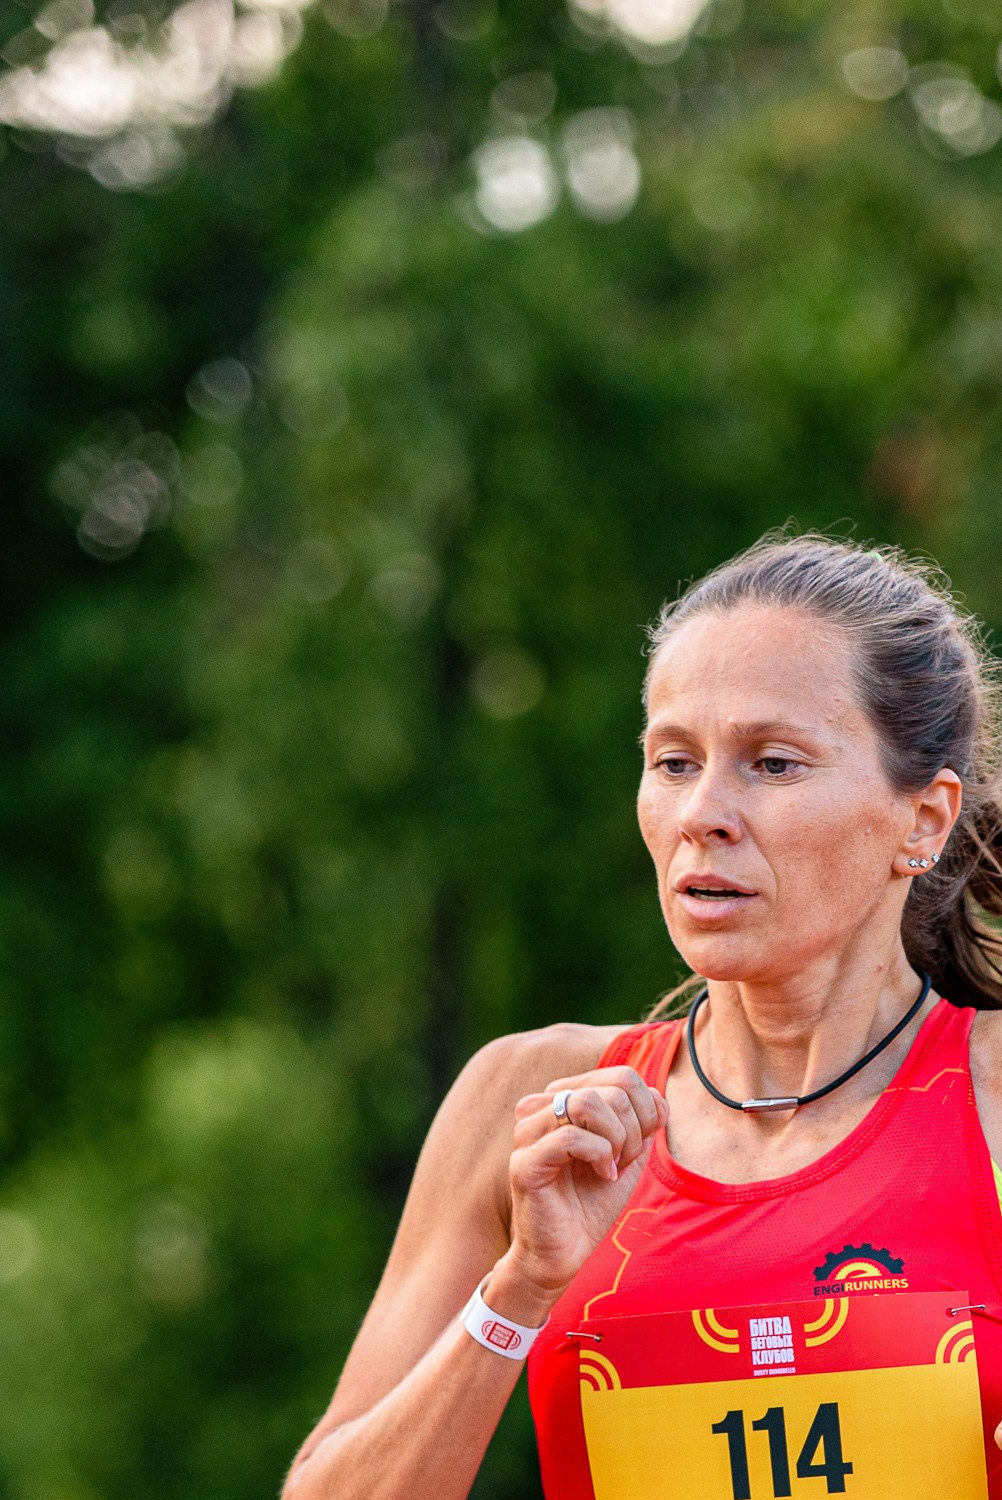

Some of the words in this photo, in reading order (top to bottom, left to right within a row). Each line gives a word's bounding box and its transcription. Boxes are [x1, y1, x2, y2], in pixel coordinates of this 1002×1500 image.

[814, 1279, 909, 1296] ENGIRUNNERS
[749, 1316, 792, 1337] БИТВА
[750, 1334, 793, 1350] БЕГОВЫХ
[752, 1348, 795, 1365] КЛУБОВ
[711, 1402, 854, 1500] 114
